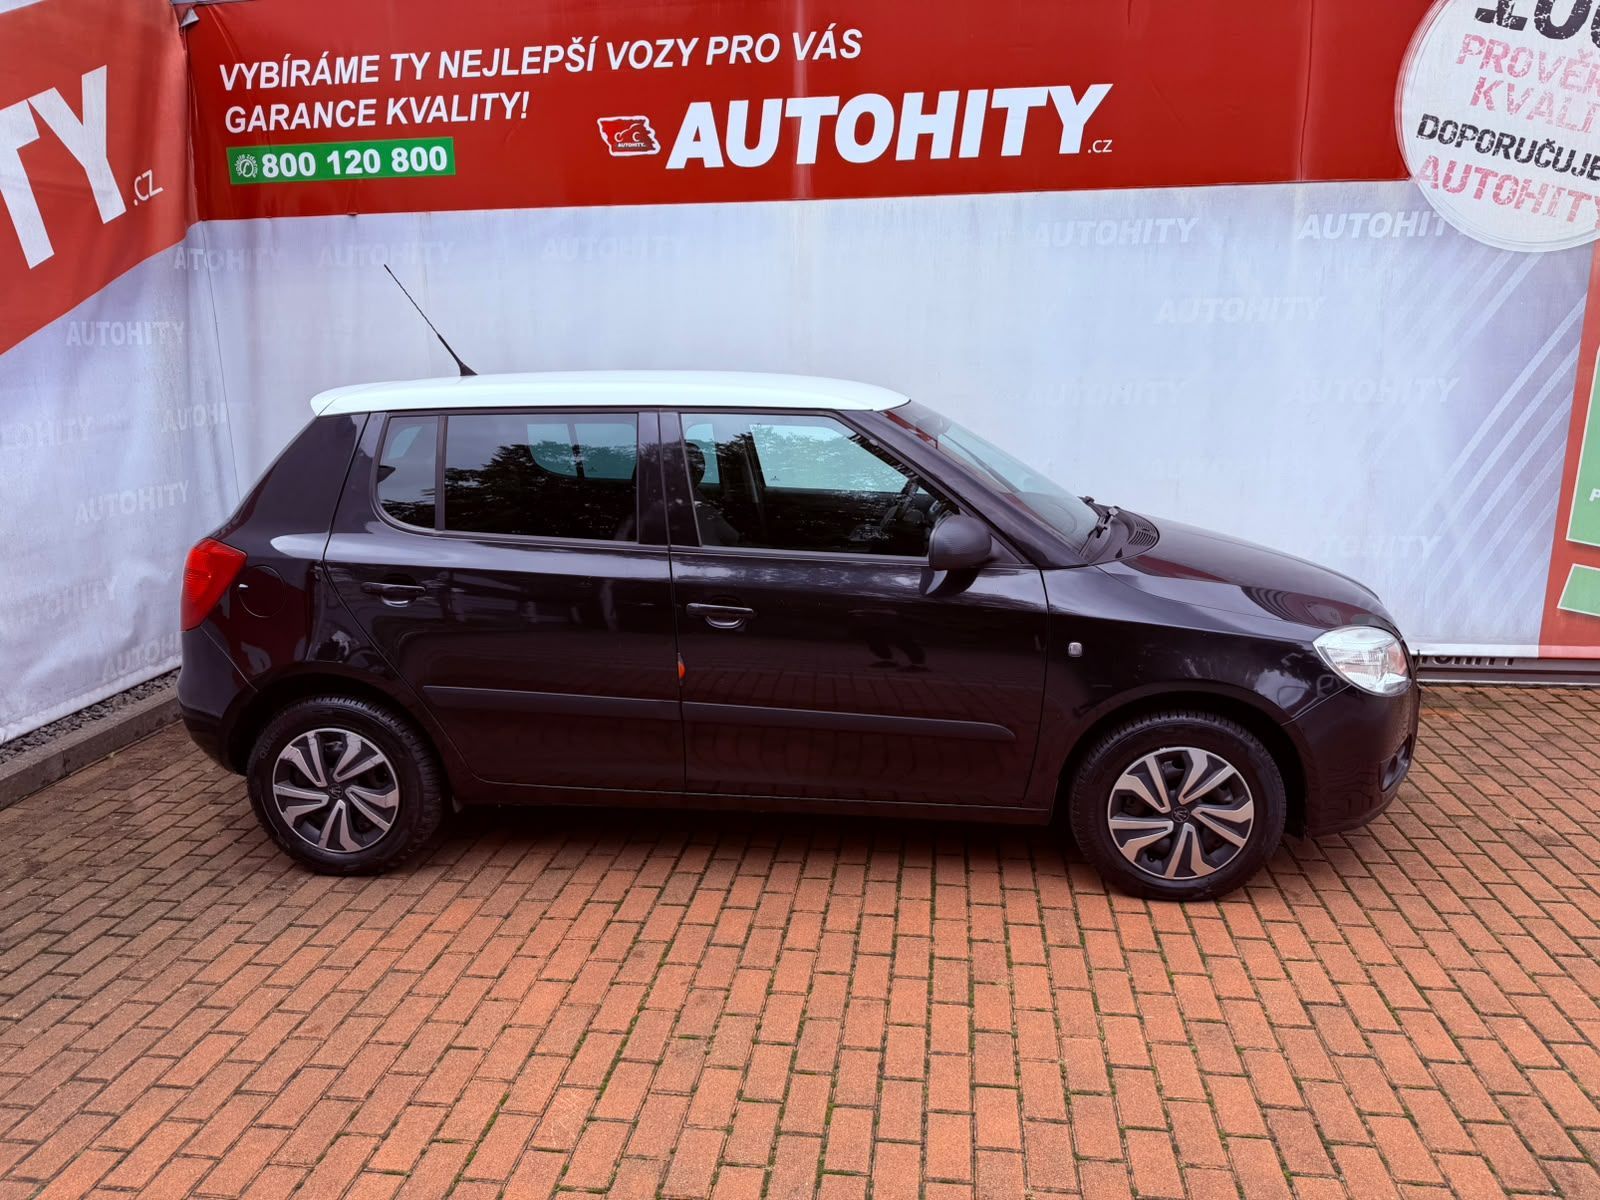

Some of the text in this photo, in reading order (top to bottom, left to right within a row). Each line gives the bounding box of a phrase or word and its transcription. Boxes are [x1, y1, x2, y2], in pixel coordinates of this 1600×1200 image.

[219, 23, 864, 91] VYBÍRÁME TY NEJLEPŠÍ VOZY PRO VÁS
[225, 91, 530, 133] GARANCE KVALITY!
[262, 152, 316, 178] 800
[327, 149, 381, 175] 120
[391, 146, 448, 173] 800
[1416, 113, 1600, 182] DOPORUČUJE
[1034, 217, 1199, 247] AUTOHITY
[1298, 210, 1446, 240] AUTOHIT
[1154, 297, 1325, 324] AUTOHITY
[66, 320, 185, 346] AUTOHITY
[75, 480, 189, 525] AUTOHITY
